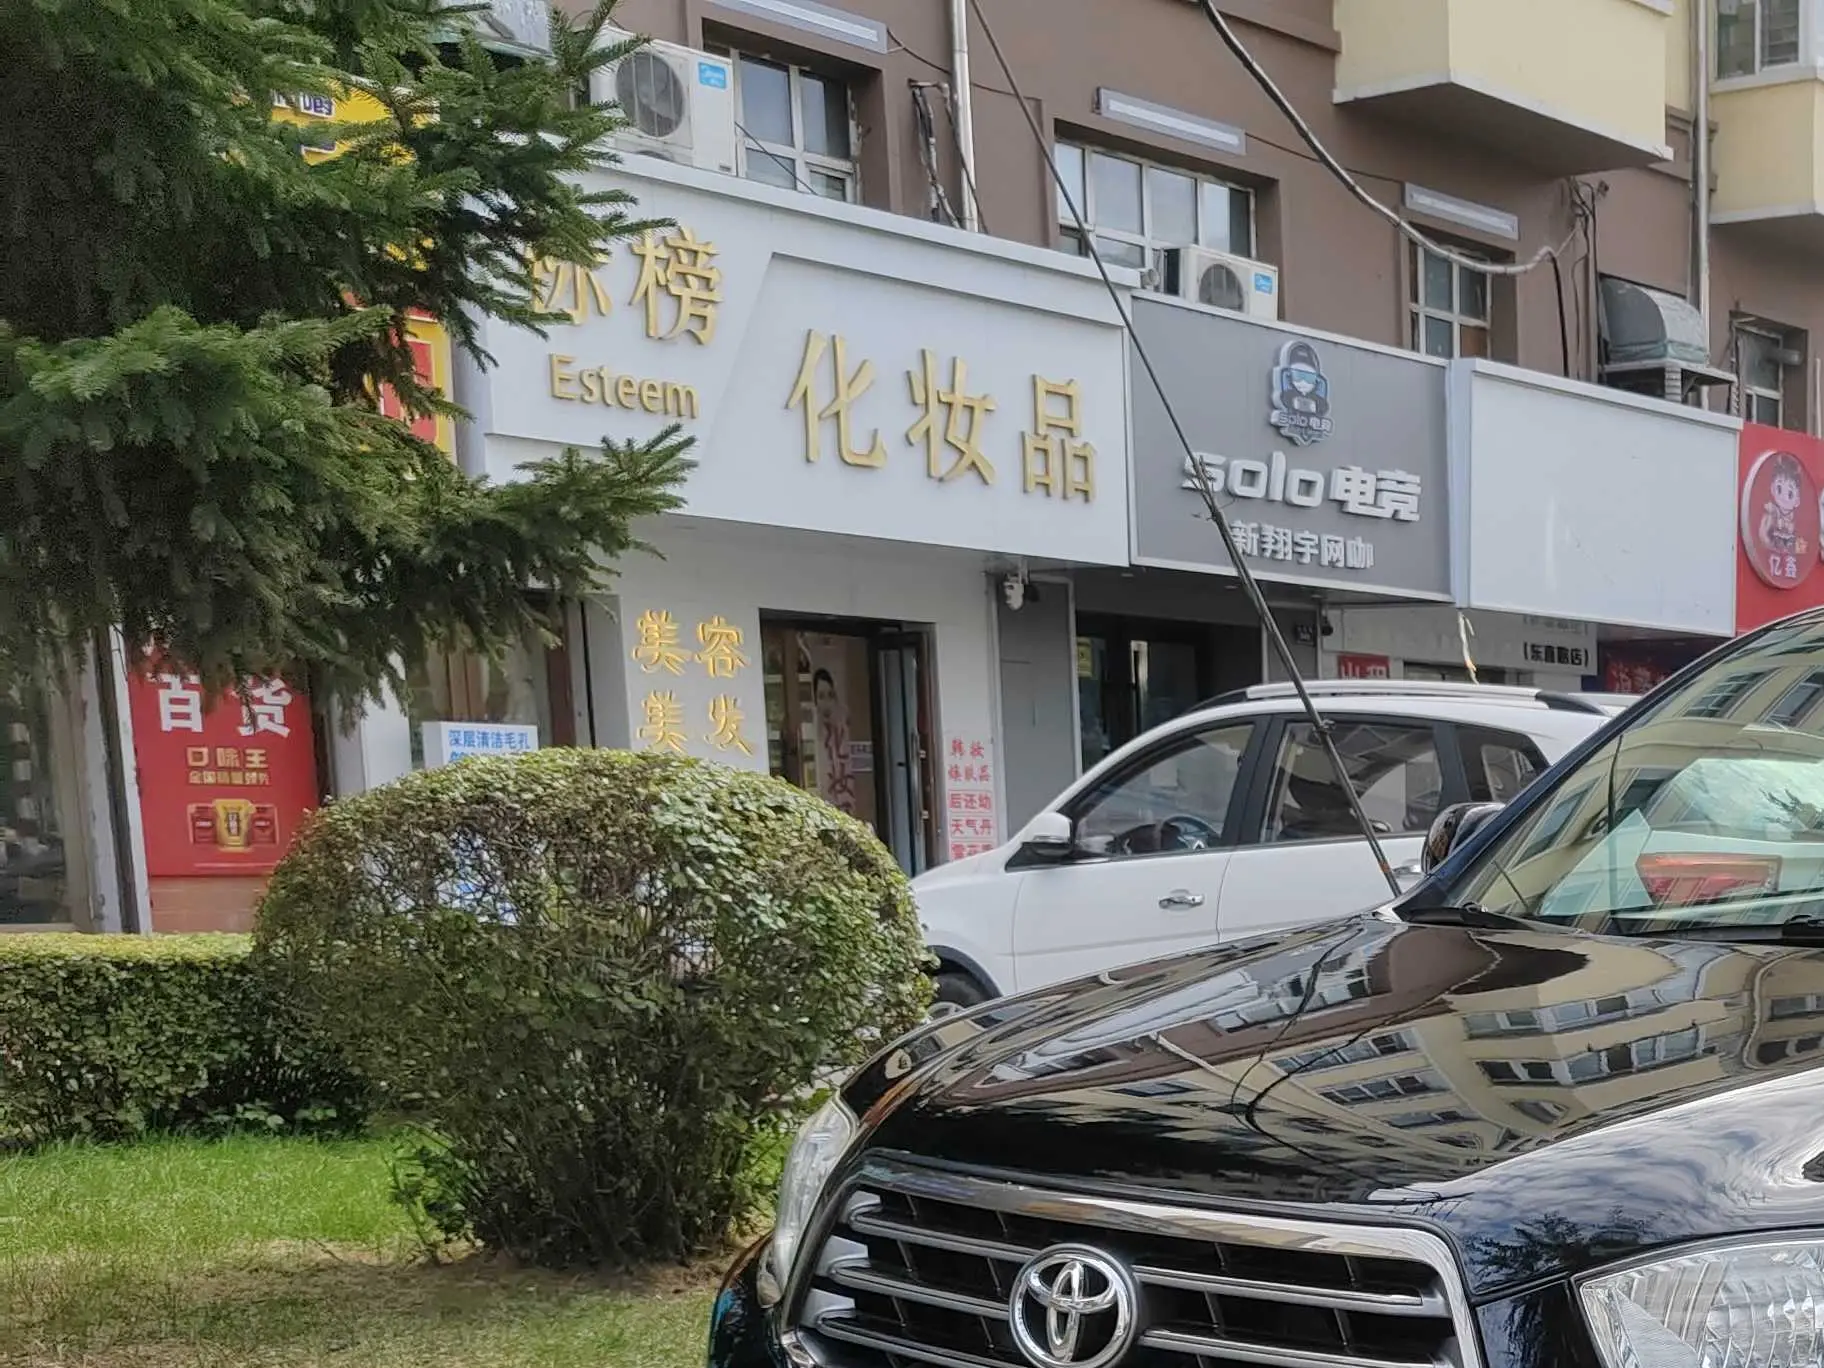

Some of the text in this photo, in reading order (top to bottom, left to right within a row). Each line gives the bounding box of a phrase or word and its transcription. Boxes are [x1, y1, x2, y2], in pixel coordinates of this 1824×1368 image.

[549, 353, 699, 420] Esteem
[785, 328, 1097, 503] 化妆品
[1229, 519, 1375, 570] 新翔宇网咖
[632, 608, 750, 678] 美容
[147, 672, 292, 738] 百货
[636, 689, 755, 759] 美发
[186, 746, 269, 769] 口味王
